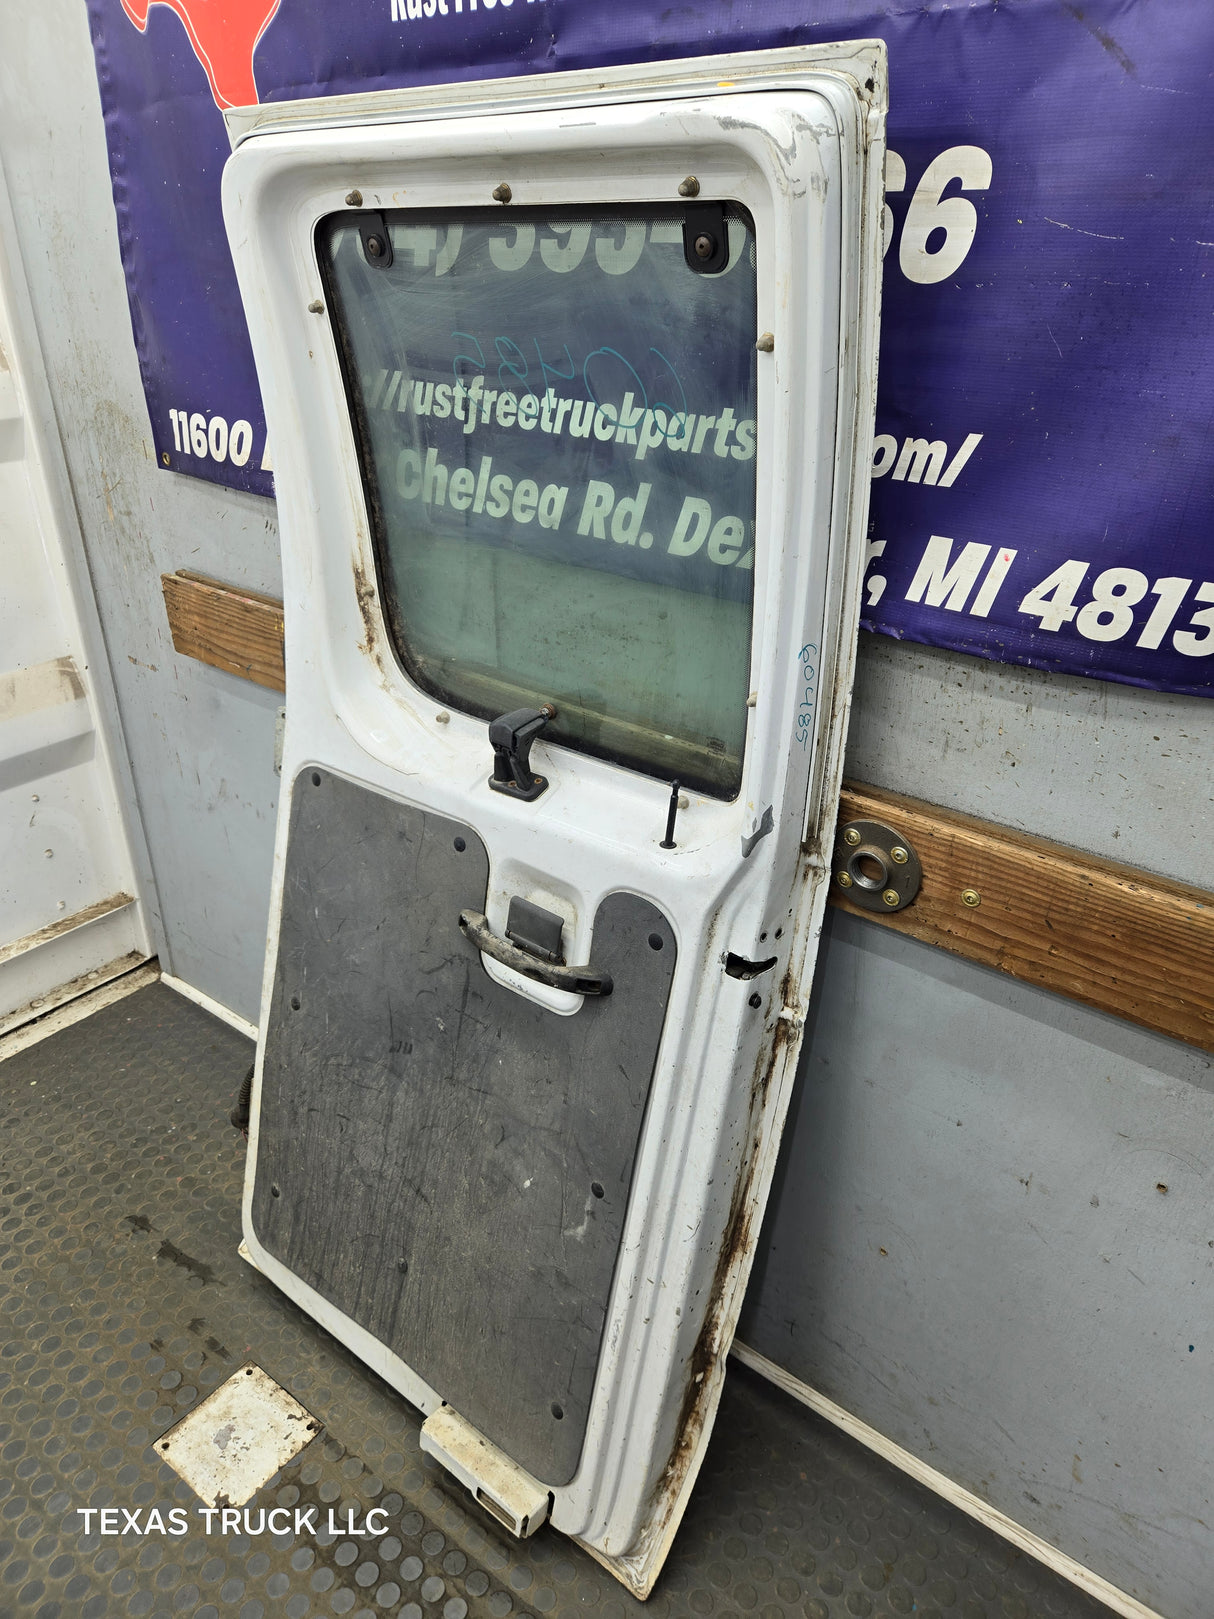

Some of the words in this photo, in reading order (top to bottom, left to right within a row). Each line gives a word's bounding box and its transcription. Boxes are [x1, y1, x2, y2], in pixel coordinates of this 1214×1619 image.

[169, 408, 253, 467] 11600
[396, 448, 569, 530] Chelsea
[577, 480, 654, 549] Rd.
[904, 535, 1018, 618] MI
